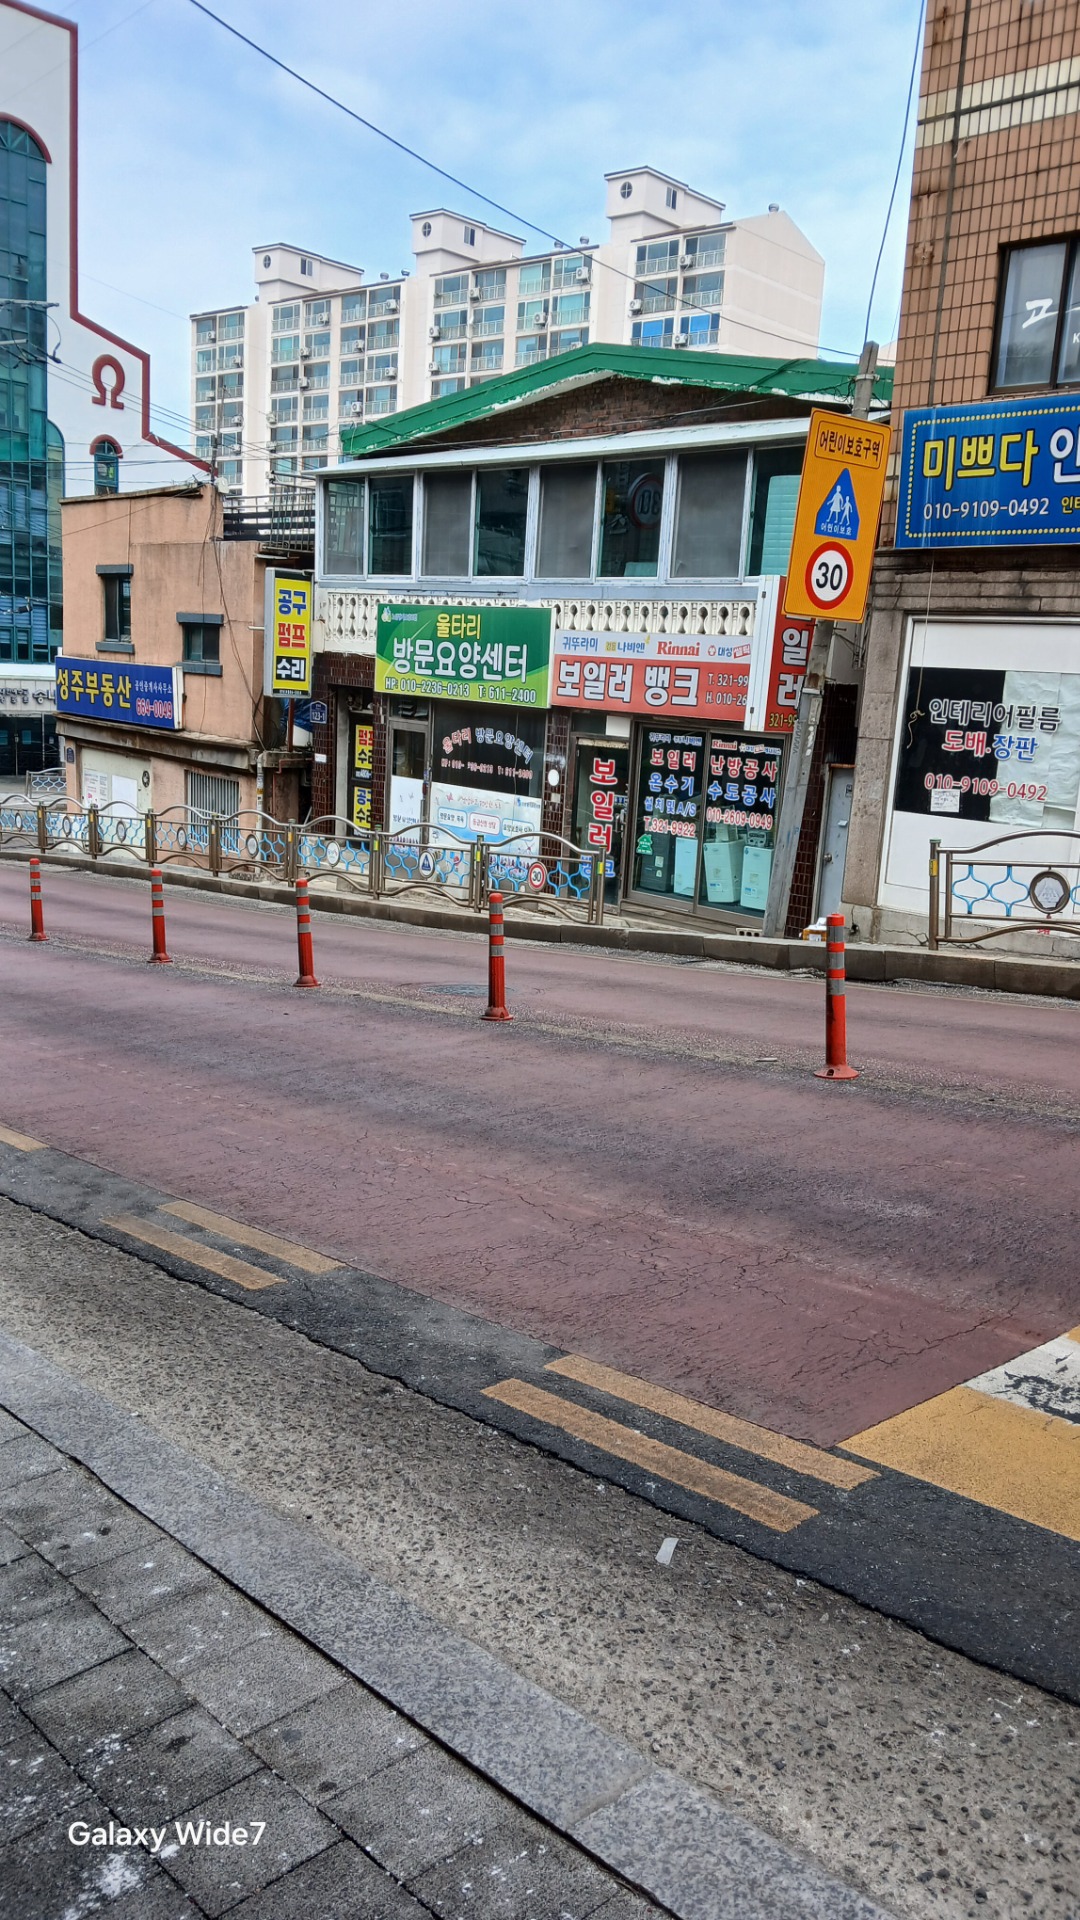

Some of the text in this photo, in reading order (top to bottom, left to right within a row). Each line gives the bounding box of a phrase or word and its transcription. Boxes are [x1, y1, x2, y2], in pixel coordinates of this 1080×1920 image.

[819, 429, 880, 463] 어린이보호구역
[922, 429, 1040, 491] 미쁘다
[923, 498, 1050, 520] 010-9109-0492
[821, 522, 852, 536] 어린이보호
[815, 561, 843, 591] 30
[278, 589, 306, 616] 공구
[278, 622, 305, 648] 펌프
[436, 612, 481, 640] 울타리
[562, 636, 599, 652] 귀뚜라미
[656, 641, 700, 657] Rinnai
[277, 658, 305, 680] 수리
[393, 637, 528, 683] 방문요양센터
[57, 668, 132, 709] 성주부동산
[385, 677, 536, 703] HP: 010-2236-0213 T: 611-2400
[557, 660, 700, 708] 보일러 뱅크
[716, 692, 747, 706] 010-26
[928, 698, 1063, 733] 인테리어필름
[442, 727, 534, 765] 울타리 방문요양센터
[712, 739, 738, 751] Rinnai
[650, 748, 697, 772] 보일러
[710, 755, 777, 782] 난방공사
[649, 772, 695, 797] 온수기
[707, 780, 776, 809] 수도공사
[924, 772, 1048, 802] 010-9109-0492
[588, 757, 618, 854] 보일러
[706, 807, 773, 830] 010-2609-0949
